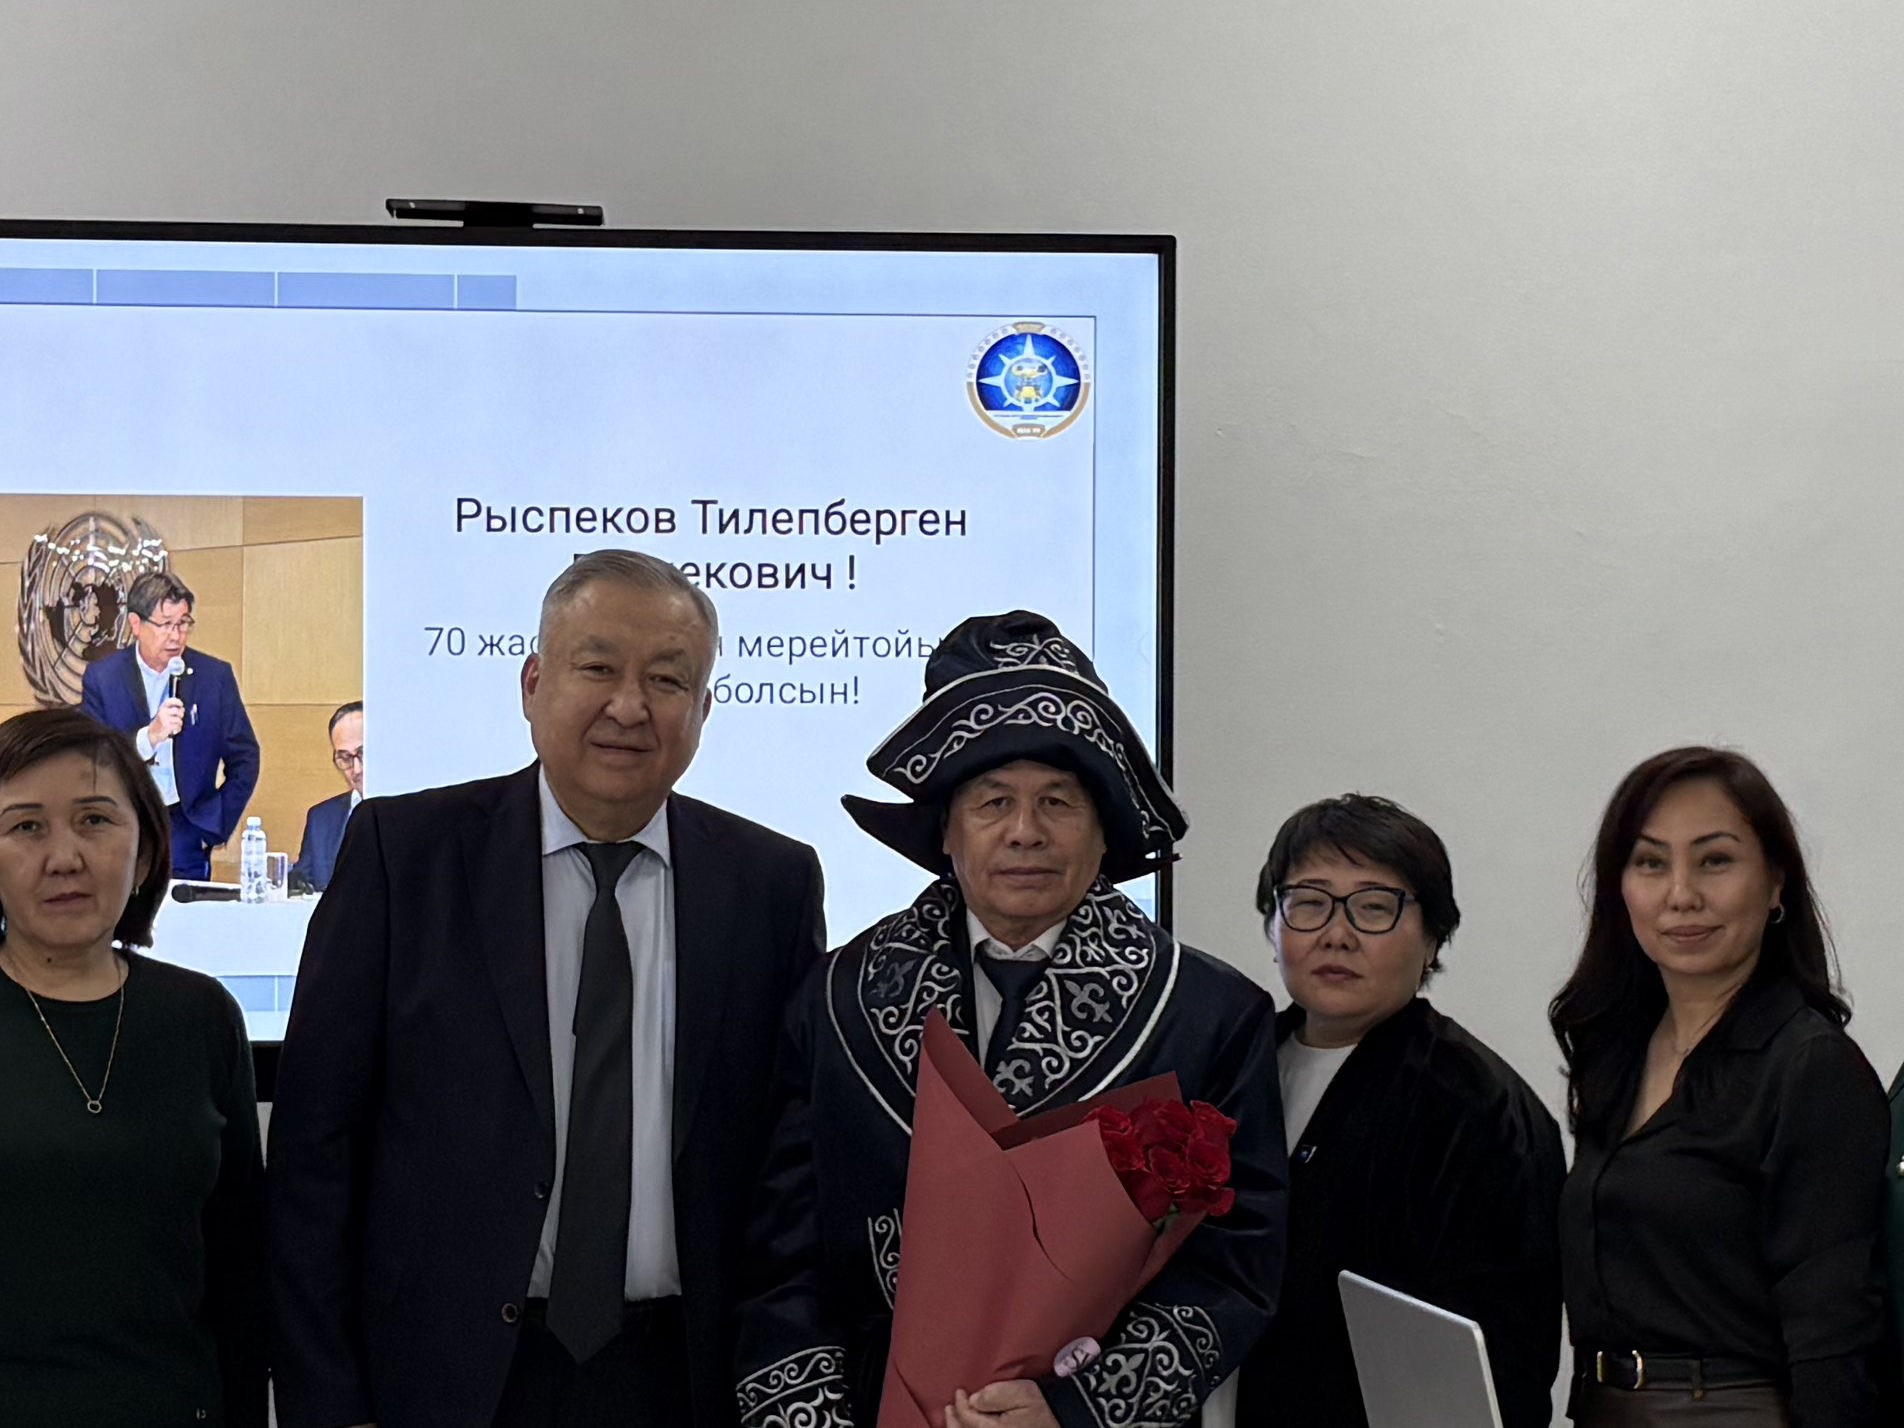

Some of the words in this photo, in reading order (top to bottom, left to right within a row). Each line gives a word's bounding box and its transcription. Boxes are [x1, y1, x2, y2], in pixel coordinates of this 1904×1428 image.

[457, 498, 677, 534] Рыспеков
[691, 498, 967, 545] Тилепберген
[424, 627, 465, 656] 70
[713, 673, 859, 705] болсын!
